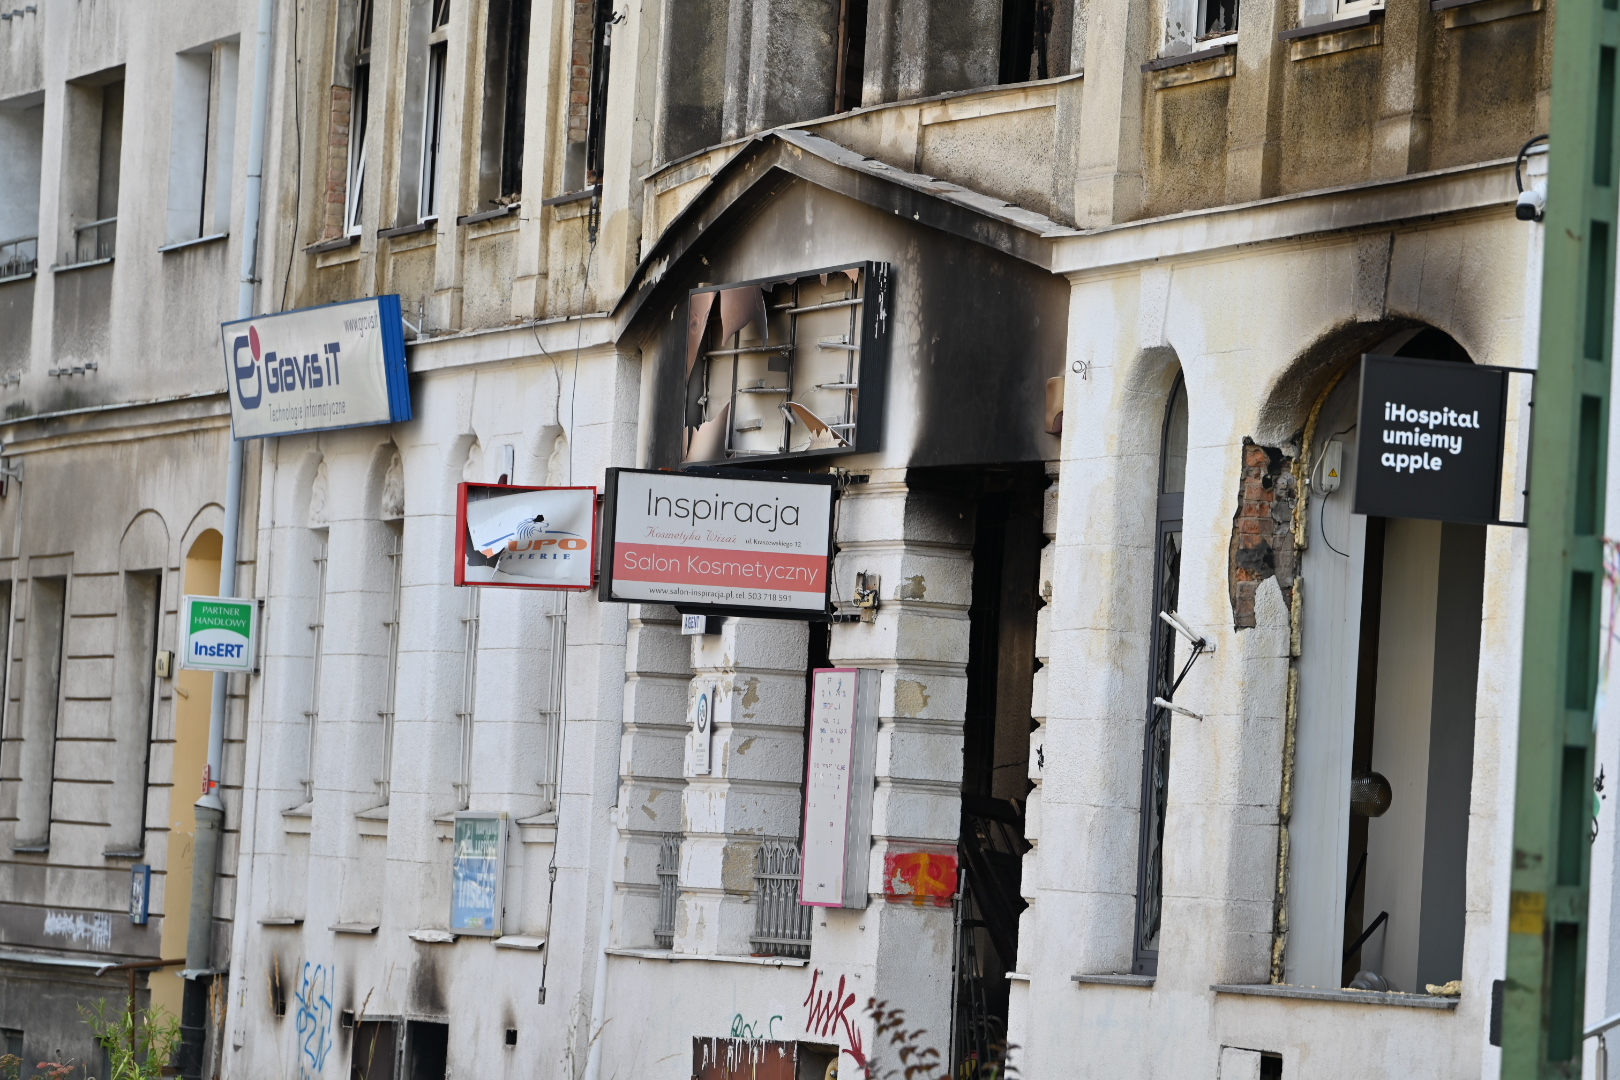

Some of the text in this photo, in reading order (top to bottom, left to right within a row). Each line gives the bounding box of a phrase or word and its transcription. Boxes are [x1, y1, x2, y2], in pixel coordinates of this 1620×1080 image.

[265, 351, 323, 394] Gravis
[268, 398, 346, 426] Technologie Informatyczne
[1384, 401, 1480, 430] iHospital
[1382, 427, 1463, 455] umiemy
[1381, 451, 1443, 474] apple
[647, 488, 800, 533] Inspiracja
[644, 526, 702, 544] Kosmetyka
[623, 551, 819, 585] Salon Kosmetyczny
[748, 592, 762, 601] 503
[763, 593, 777, 602] 718
[778, 594, 792, 602] 591
[194, 616, 247, 628] HANDLOWY
[202, 605, 240, 616] PARTNER
[684, 616, 700, 629] AGENT
[194, 641, 244, 658] InsERT
